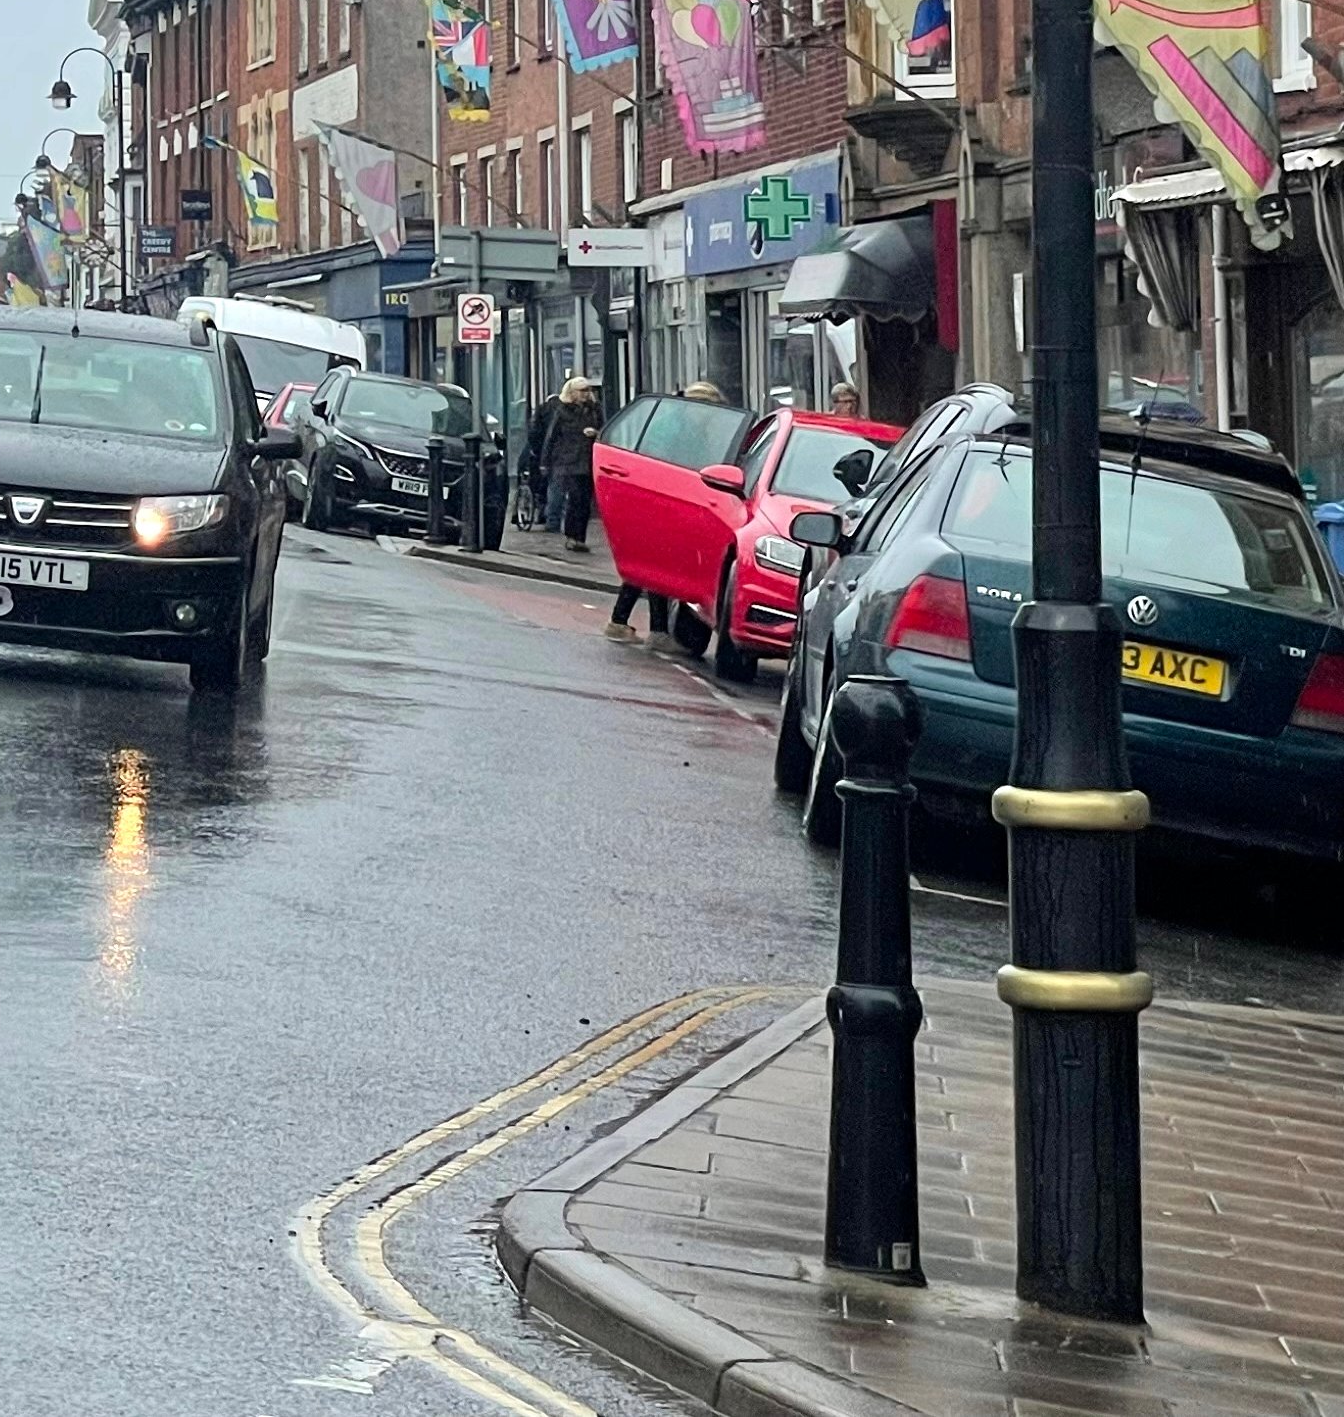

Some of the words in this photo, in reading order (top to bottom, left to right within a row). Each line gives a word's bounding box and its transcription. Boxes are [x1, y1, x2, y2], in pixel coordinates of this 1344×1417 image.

[385, 293, 408, 305] IRO
[30, 560, 73, 585] VTL
[1122, 645, 1141, 670] 3
[1149, 651, 1209, 684] AXC
